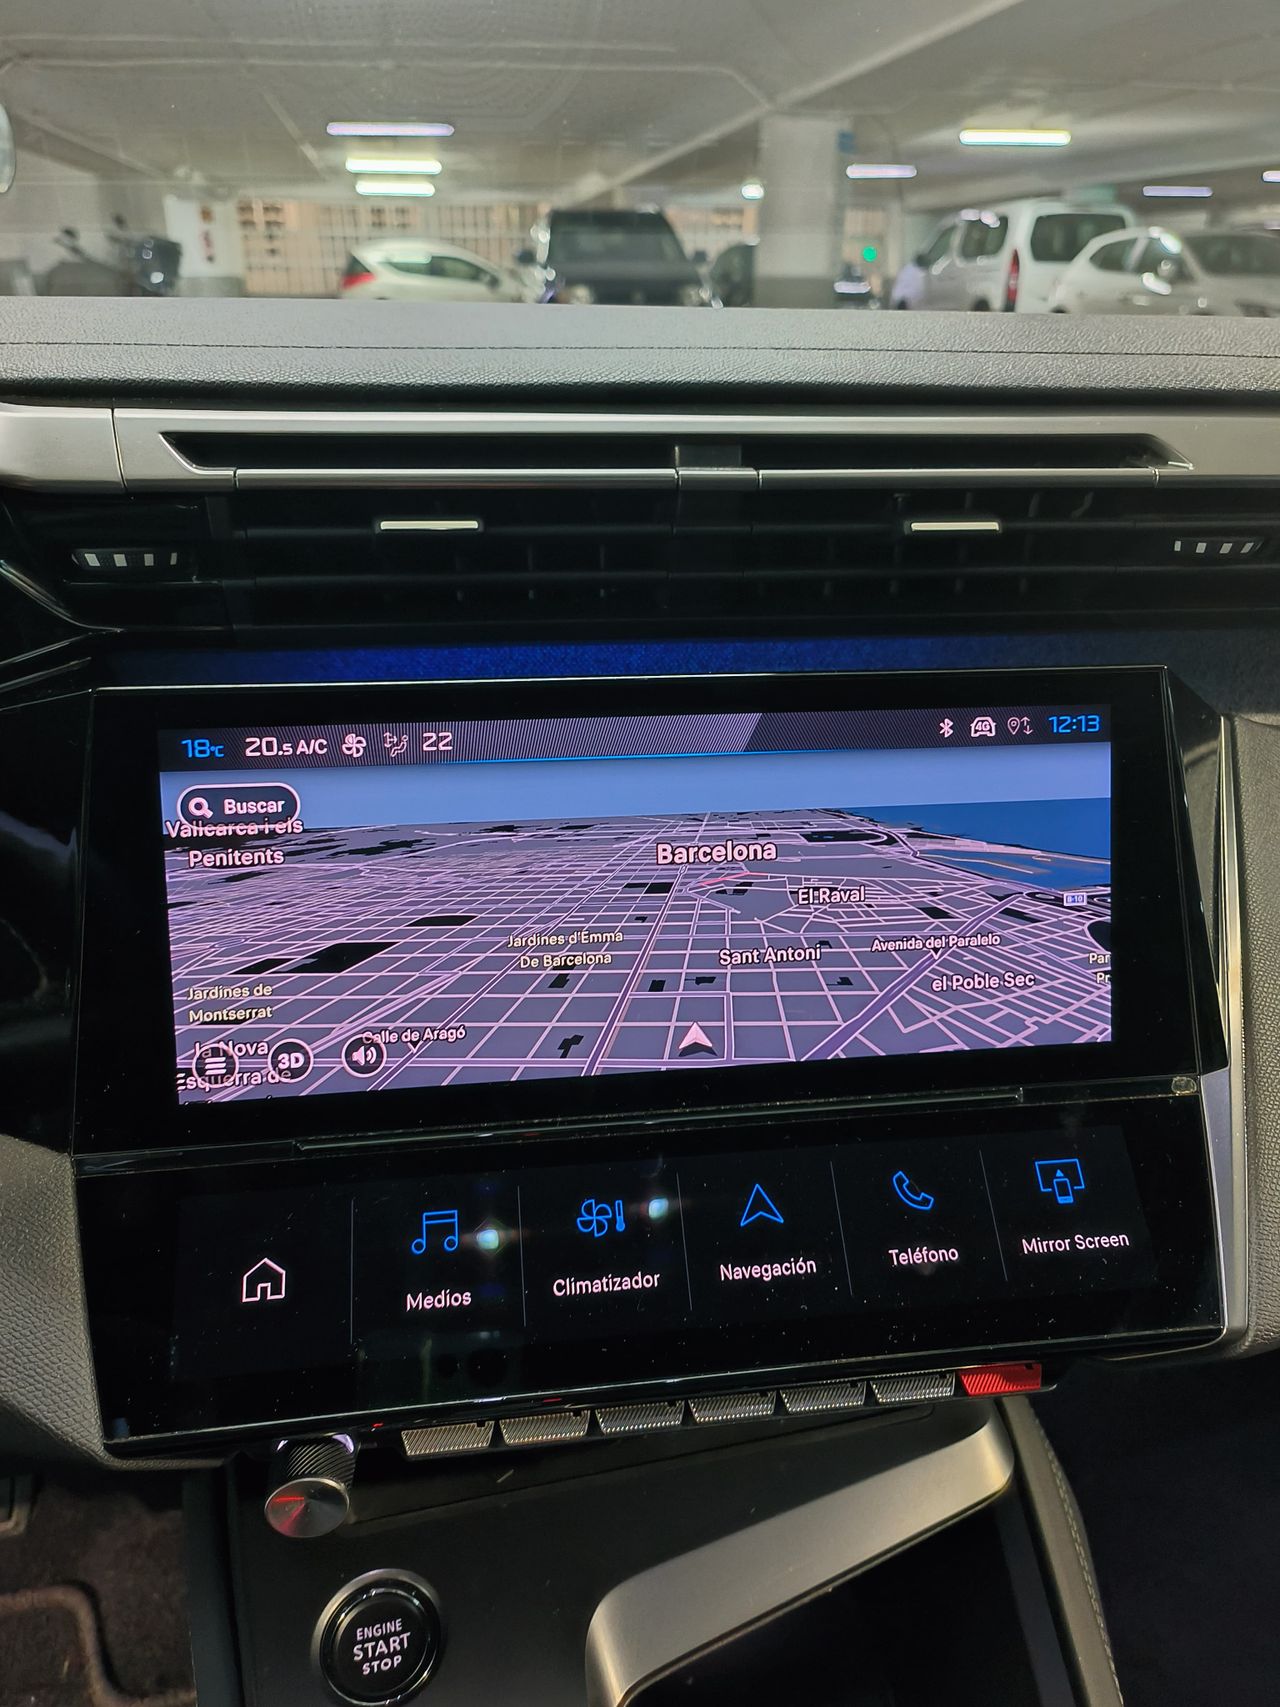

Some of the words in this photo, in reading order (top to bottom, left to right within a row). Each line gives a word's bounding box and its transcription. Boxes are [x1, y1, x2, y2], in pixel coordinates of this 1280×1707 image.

[1049, 714, 1101, 734] 12:13
[296, 738, 328, 755] A/C
[422, 732, 453, 751] 22
[223, 798, 285, 816] Buscar
[188, 848, 285, 868] Penitents
[656, 841, 778, 866] Barcelona
[798, 888, 813, 905] El
[818, 885, 866, 904] Raval
[508, 935, 565, 949] Jardines
[568, 930, 624, 946] d'Emma
[871, 938, 922, 952] Avenida
[925, 936, 946, 949] del
[949, 933, 1001, 948] Paralelo
[520, 955, 539, 968] De
[543, 952, 612, 967] Barcelona
[719, 949, 759, 966] Sant
[764, 944, 822, 963] Antoni
[187, 985, 249, 1001] Jardines
[253, 983, 273, 997] de
[931, 975, 947, 992] el
[951, 974, 999, 991] Poble
[1004, 972, 1036, 988] Sec
[189, 1006, 272, 1023] Montserrat
[401, 1029, 420, 1042] de
[423, 1025, 466, 1042] Aragó
[277, 1053, 304, 1069] 3D
[1021, 1237, 1071, 1255] Mirror
[1074, 1231, 1130, 1251] Screen
[888, 1245, 960, 1266] Teléfono
[719, 1257, 817, 1282] Navegación
[553, 1270, 661, 1297] Climatizador
[405, 1288, 472, 1311] Medios
[356, 1618, 403, 1641] ENGINE
[353, 1632, 411, 1661] START
[362, 1655, 402, 1675] STOP
